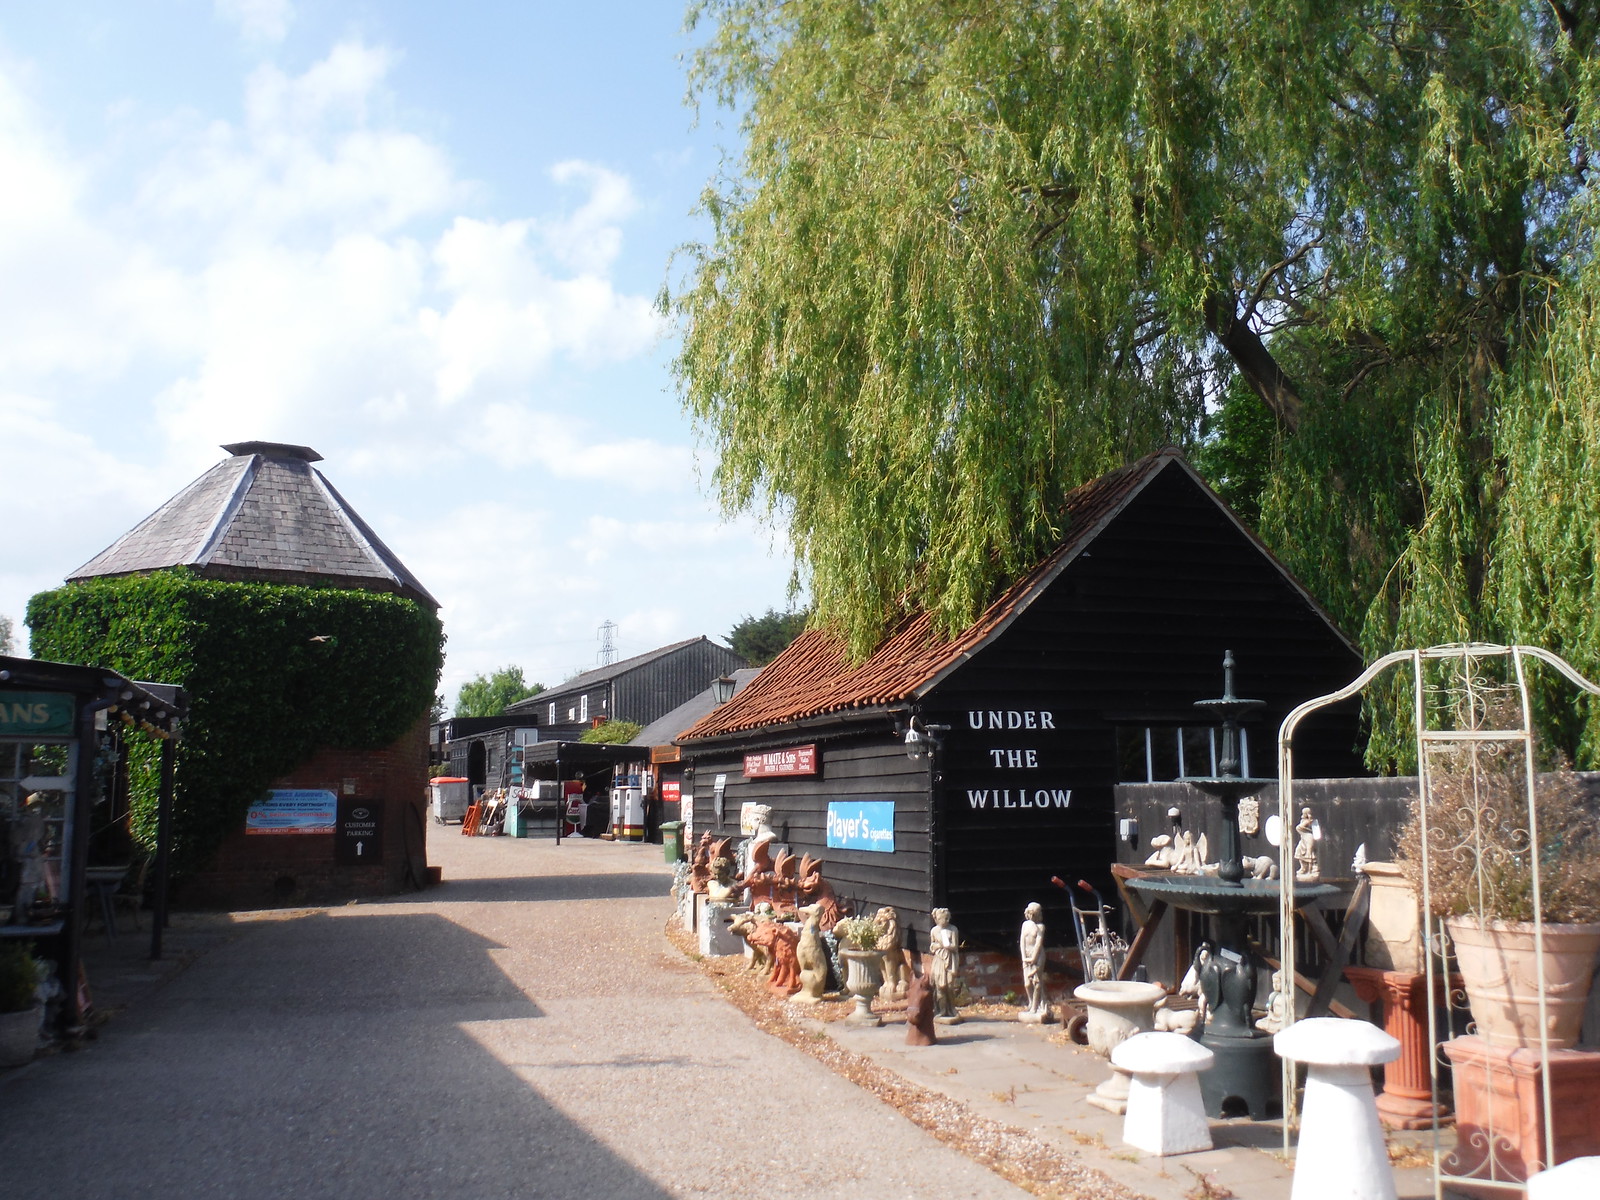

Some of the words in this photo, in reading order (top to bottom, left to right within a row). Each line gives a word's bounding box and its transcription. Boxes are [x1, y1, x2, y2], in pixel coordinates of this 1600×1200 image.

[968, 710, 1056, 730] UNDER
[990, 749, 1038, 768] THE
[967, 789, 1072, 808] WILLOW
[827, 810, 869, 844] Player's
[870, 828, 893, 842] cigarettes
